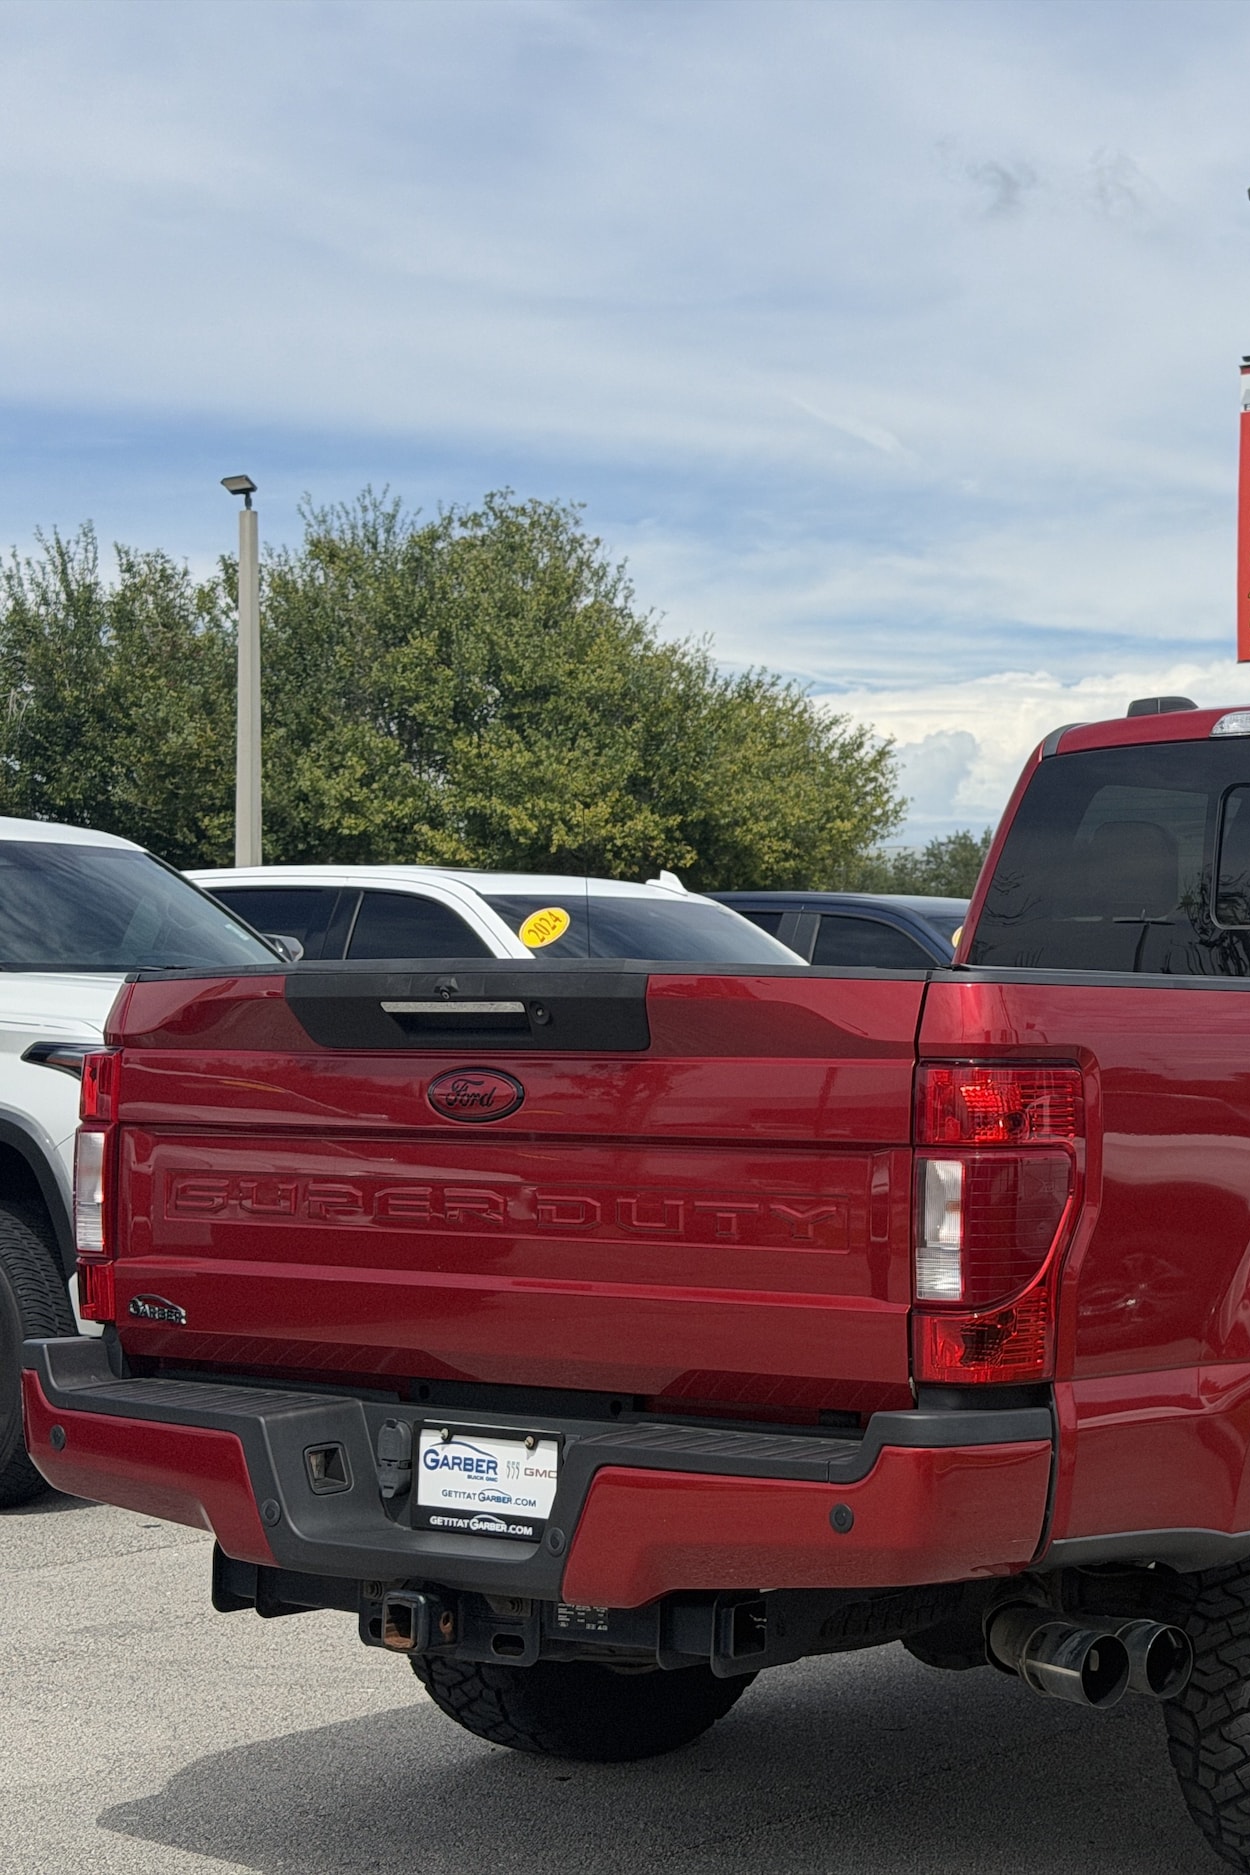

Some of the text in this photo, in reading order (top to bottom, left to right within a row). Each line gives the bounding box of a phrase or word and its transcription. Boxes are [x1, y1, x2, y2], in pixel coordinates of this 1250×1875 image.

[527, 910, 563, 943] 2024
[445, 1078, 497, 1108] Ford
[175, 1178, 838, 1241] SUPER DUTY
[423, 1448, 498, 1476] GARBER
[524, 1467, 557, 1480] GMC
